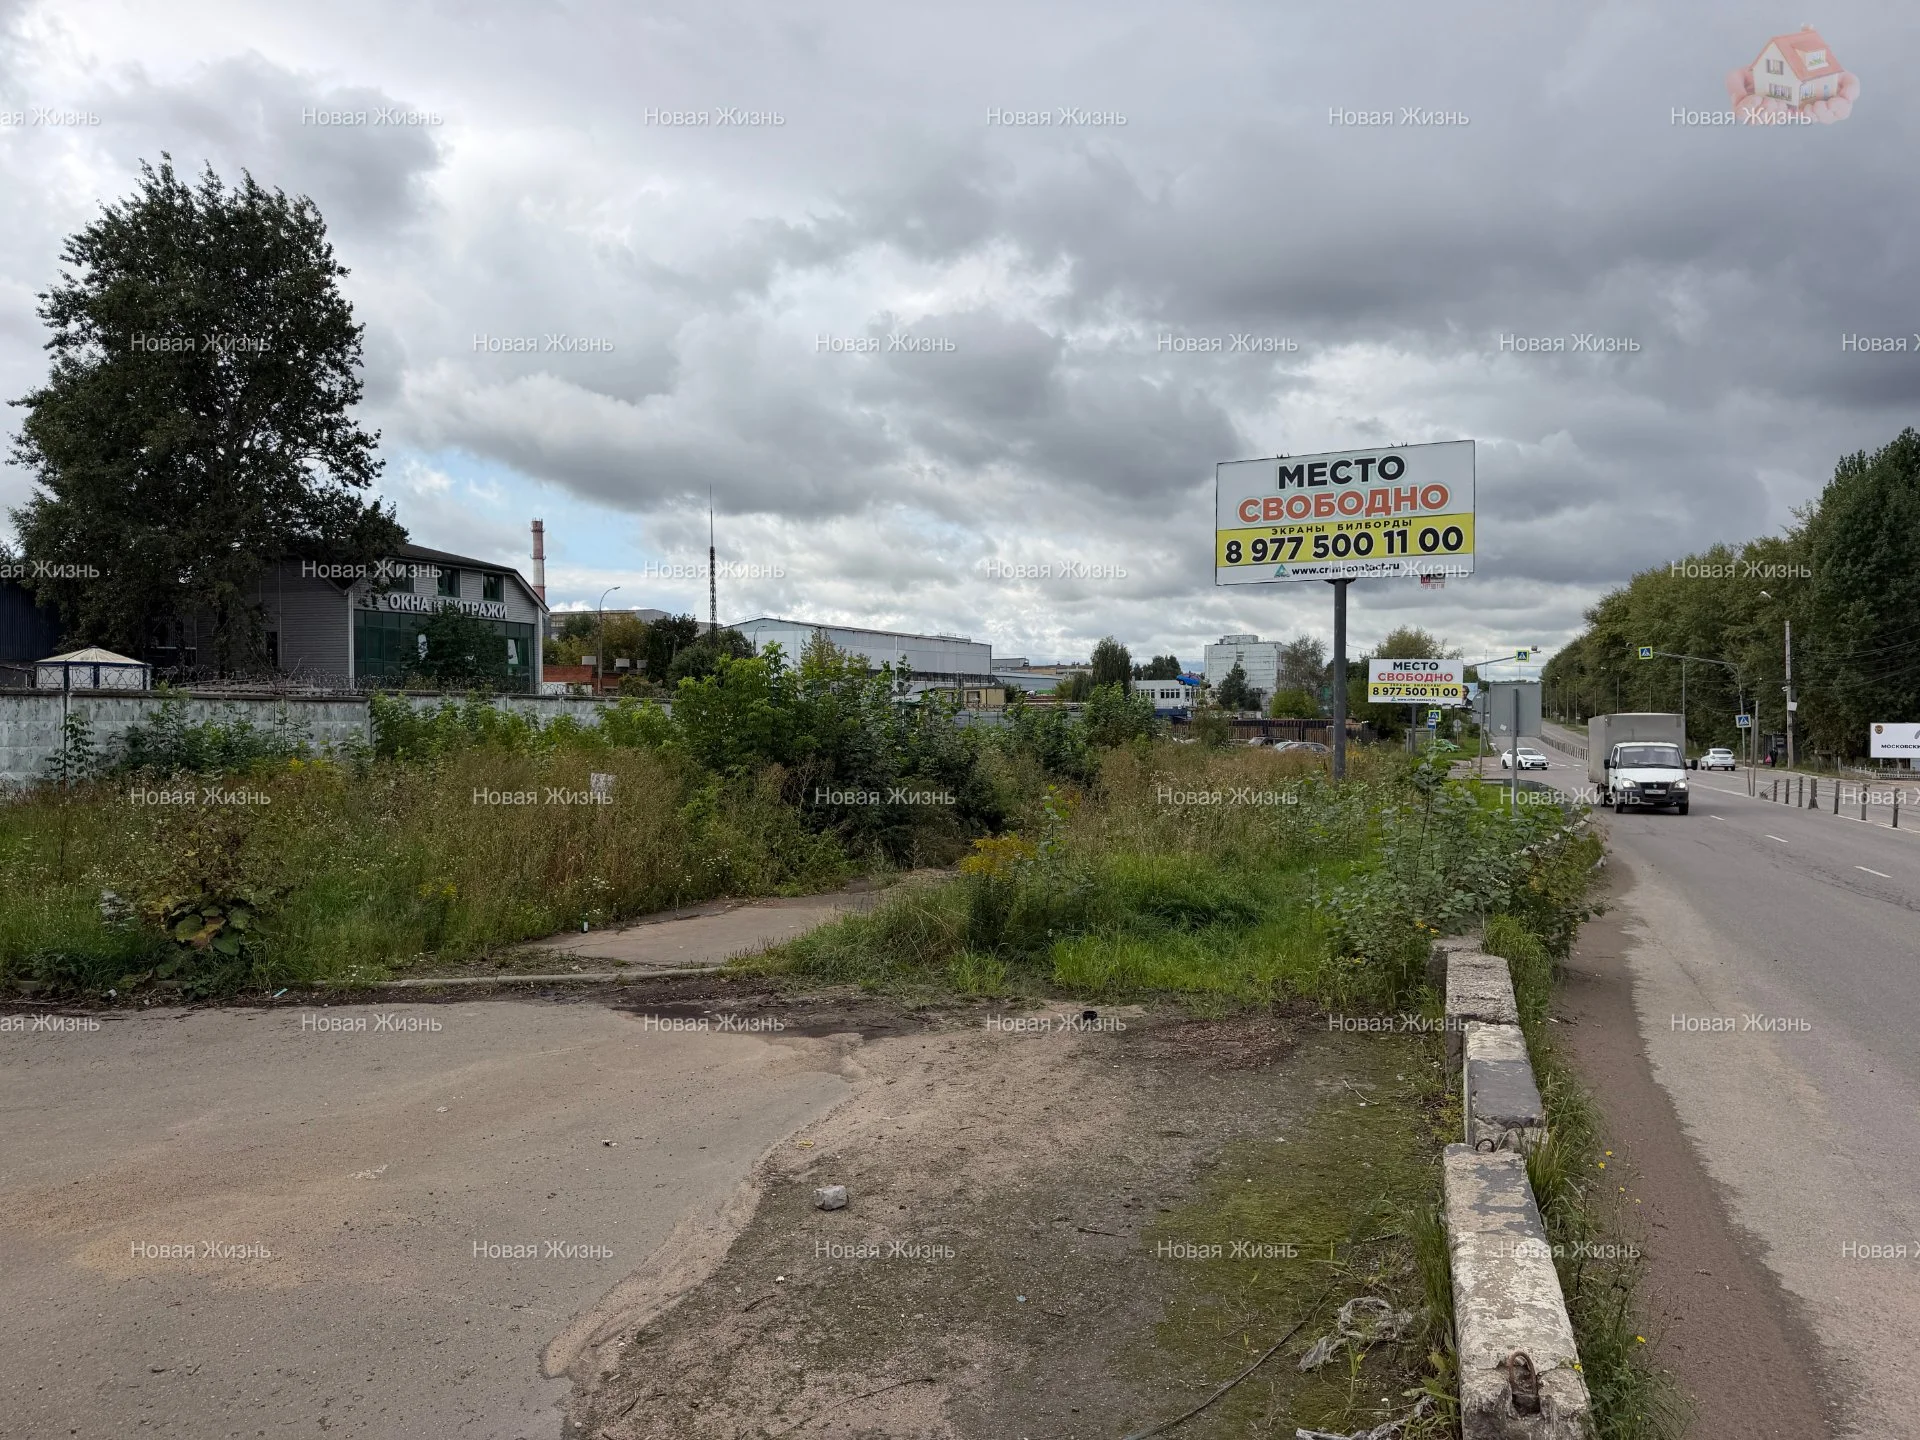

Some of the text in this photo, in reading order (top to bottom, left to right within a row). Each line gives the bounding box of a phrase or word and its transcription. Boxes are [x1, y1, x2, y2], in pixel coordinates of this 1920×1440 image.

[1278, 455, 1405, 490] МЕСТО
[1238, 484, 1449, 522] СВОБОДНО
[1271, 519, 1412, 536] ЭКРАНЫ БИЛБОРДЫ
[1225, 526, 1464, 564] 8 977 500 11 00
[389, 593, 430, 612] ОКНА
[1393, 662, 1438, 670] МЕСТО
[1378, 672, 1454, 682] СВОБОДНО
[1372, 686, 1458, 696] 8 977 500 11 00
